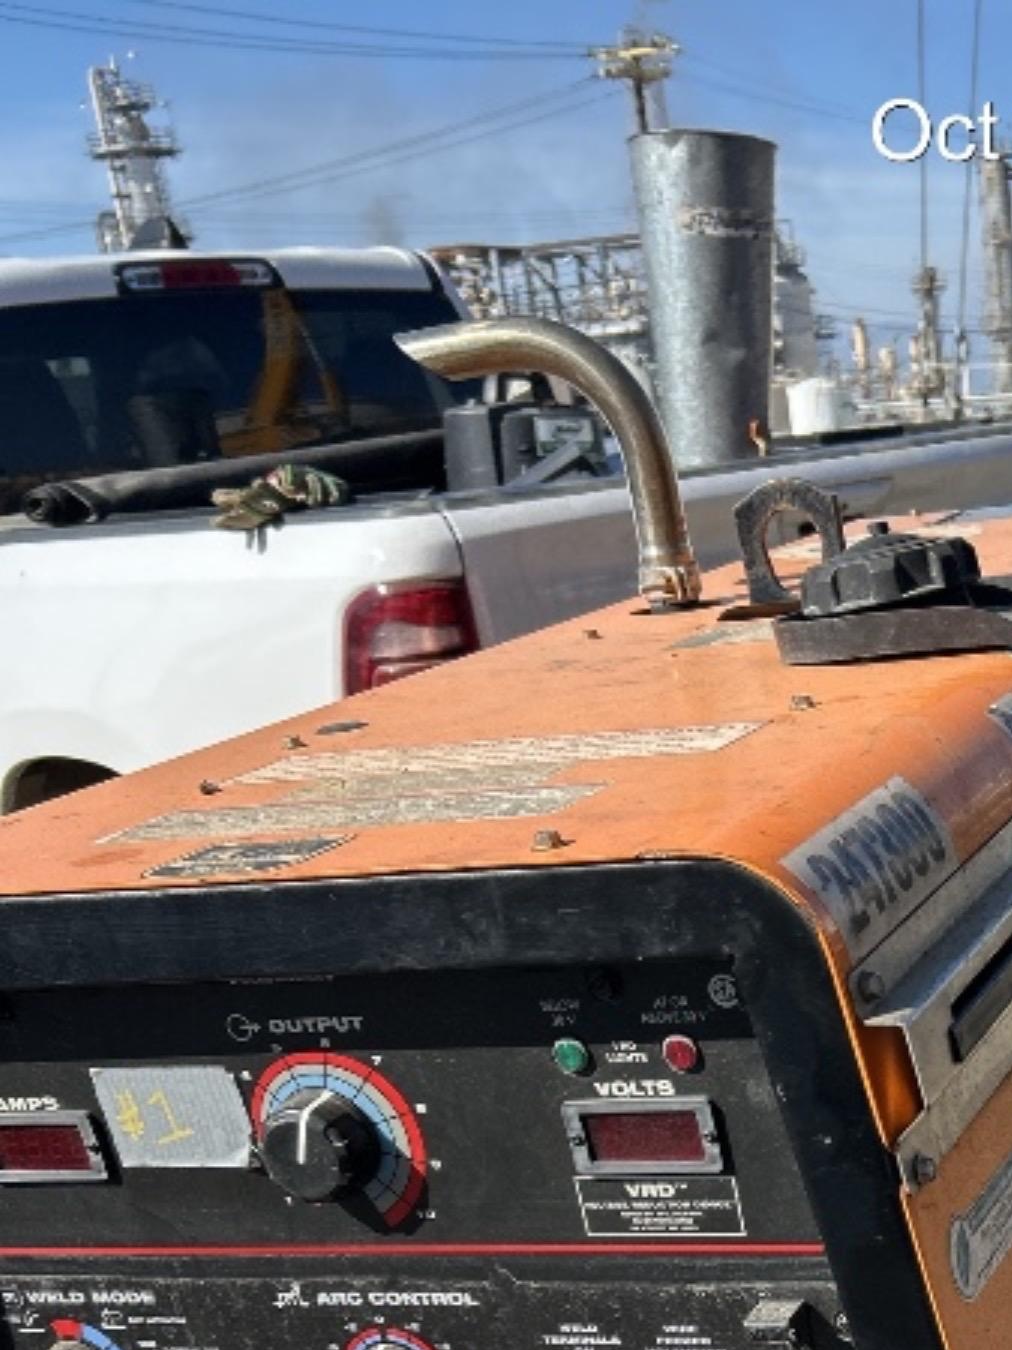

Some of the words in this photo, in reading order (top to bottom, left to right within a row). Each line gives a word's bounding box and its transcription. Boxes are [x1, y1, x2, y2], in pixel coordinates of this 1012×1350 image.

[268, 1016, 363, 1033] OUTPUT
[592, 1079, 676, 1097] VOLTS
[316, 1292, 364, 1306] ARC
[368, 1292, 480, 1306] CONTROL
